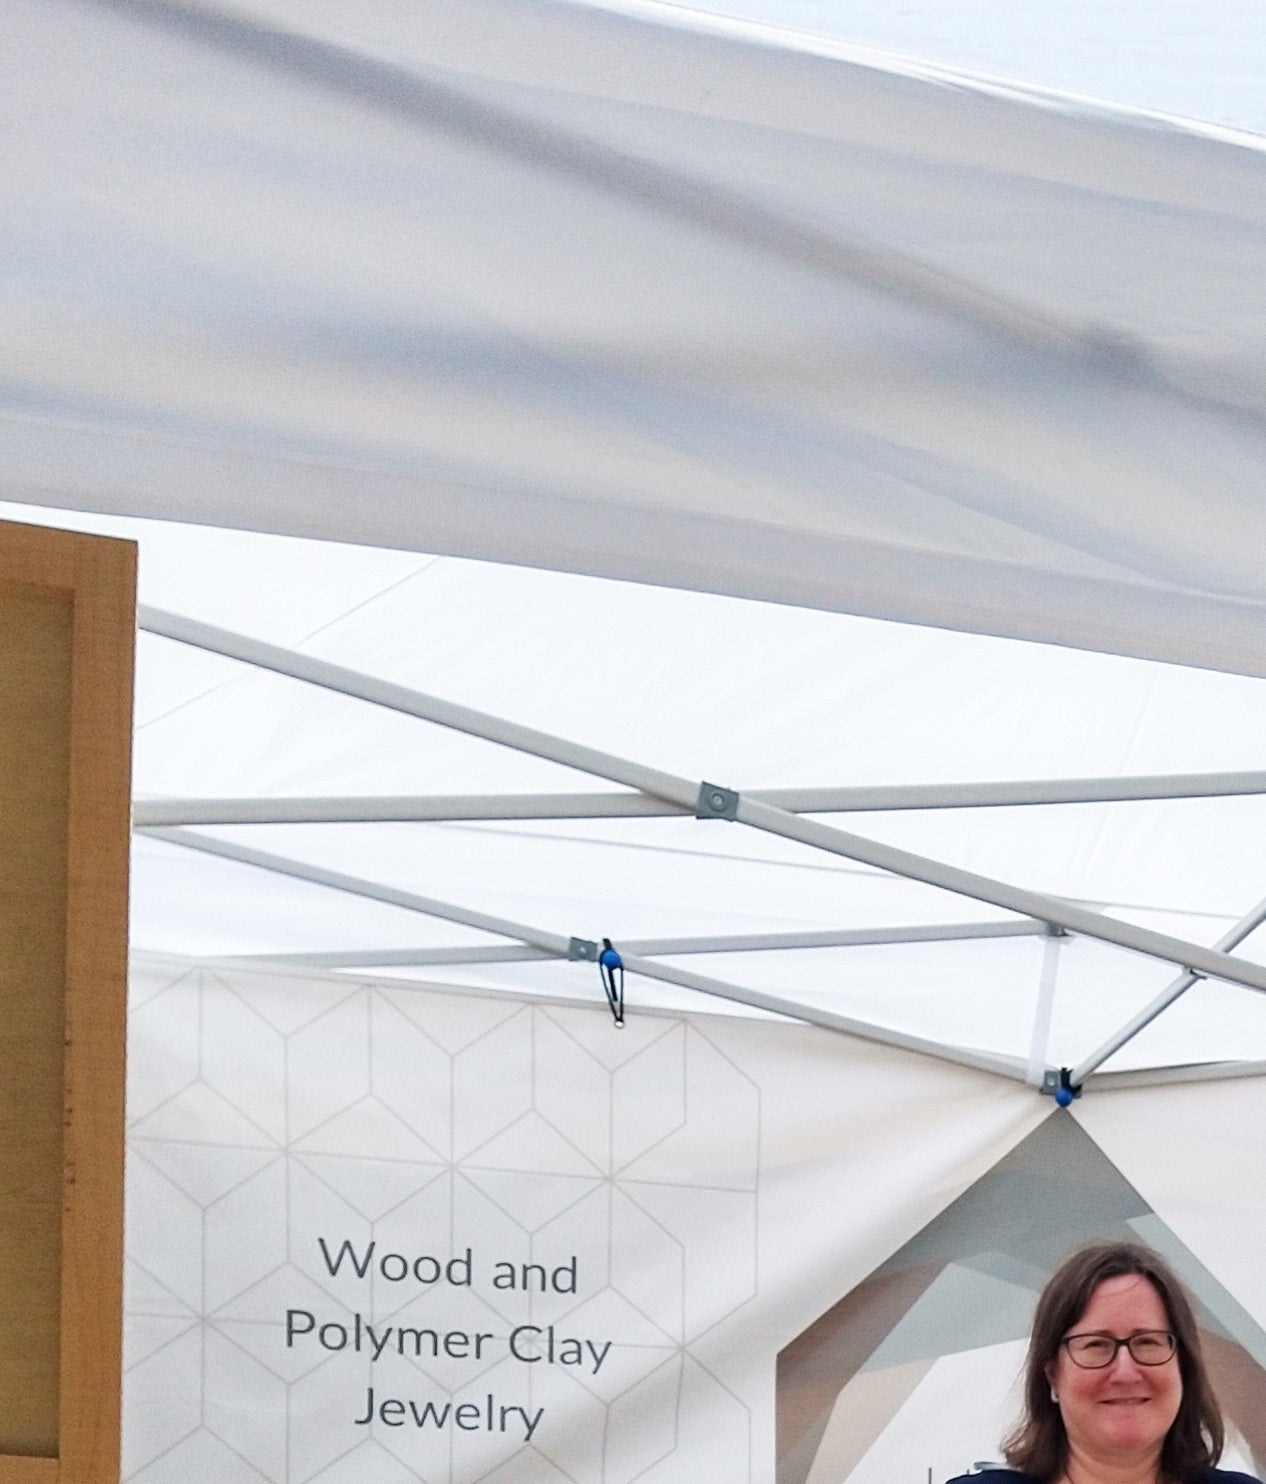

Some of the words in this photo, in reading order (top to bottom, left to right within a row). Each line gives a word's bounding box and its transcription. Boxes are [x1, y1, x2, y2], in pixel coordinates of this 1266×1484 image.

[317, 1237, 472, 1287] Wood
[493, 1255, 577, 1294] and
[286, 1309, 494, 1362] Polymer
[509, 1325, 612, 1375] Clay
[354, 1387, 545, 1443] Jewelry
